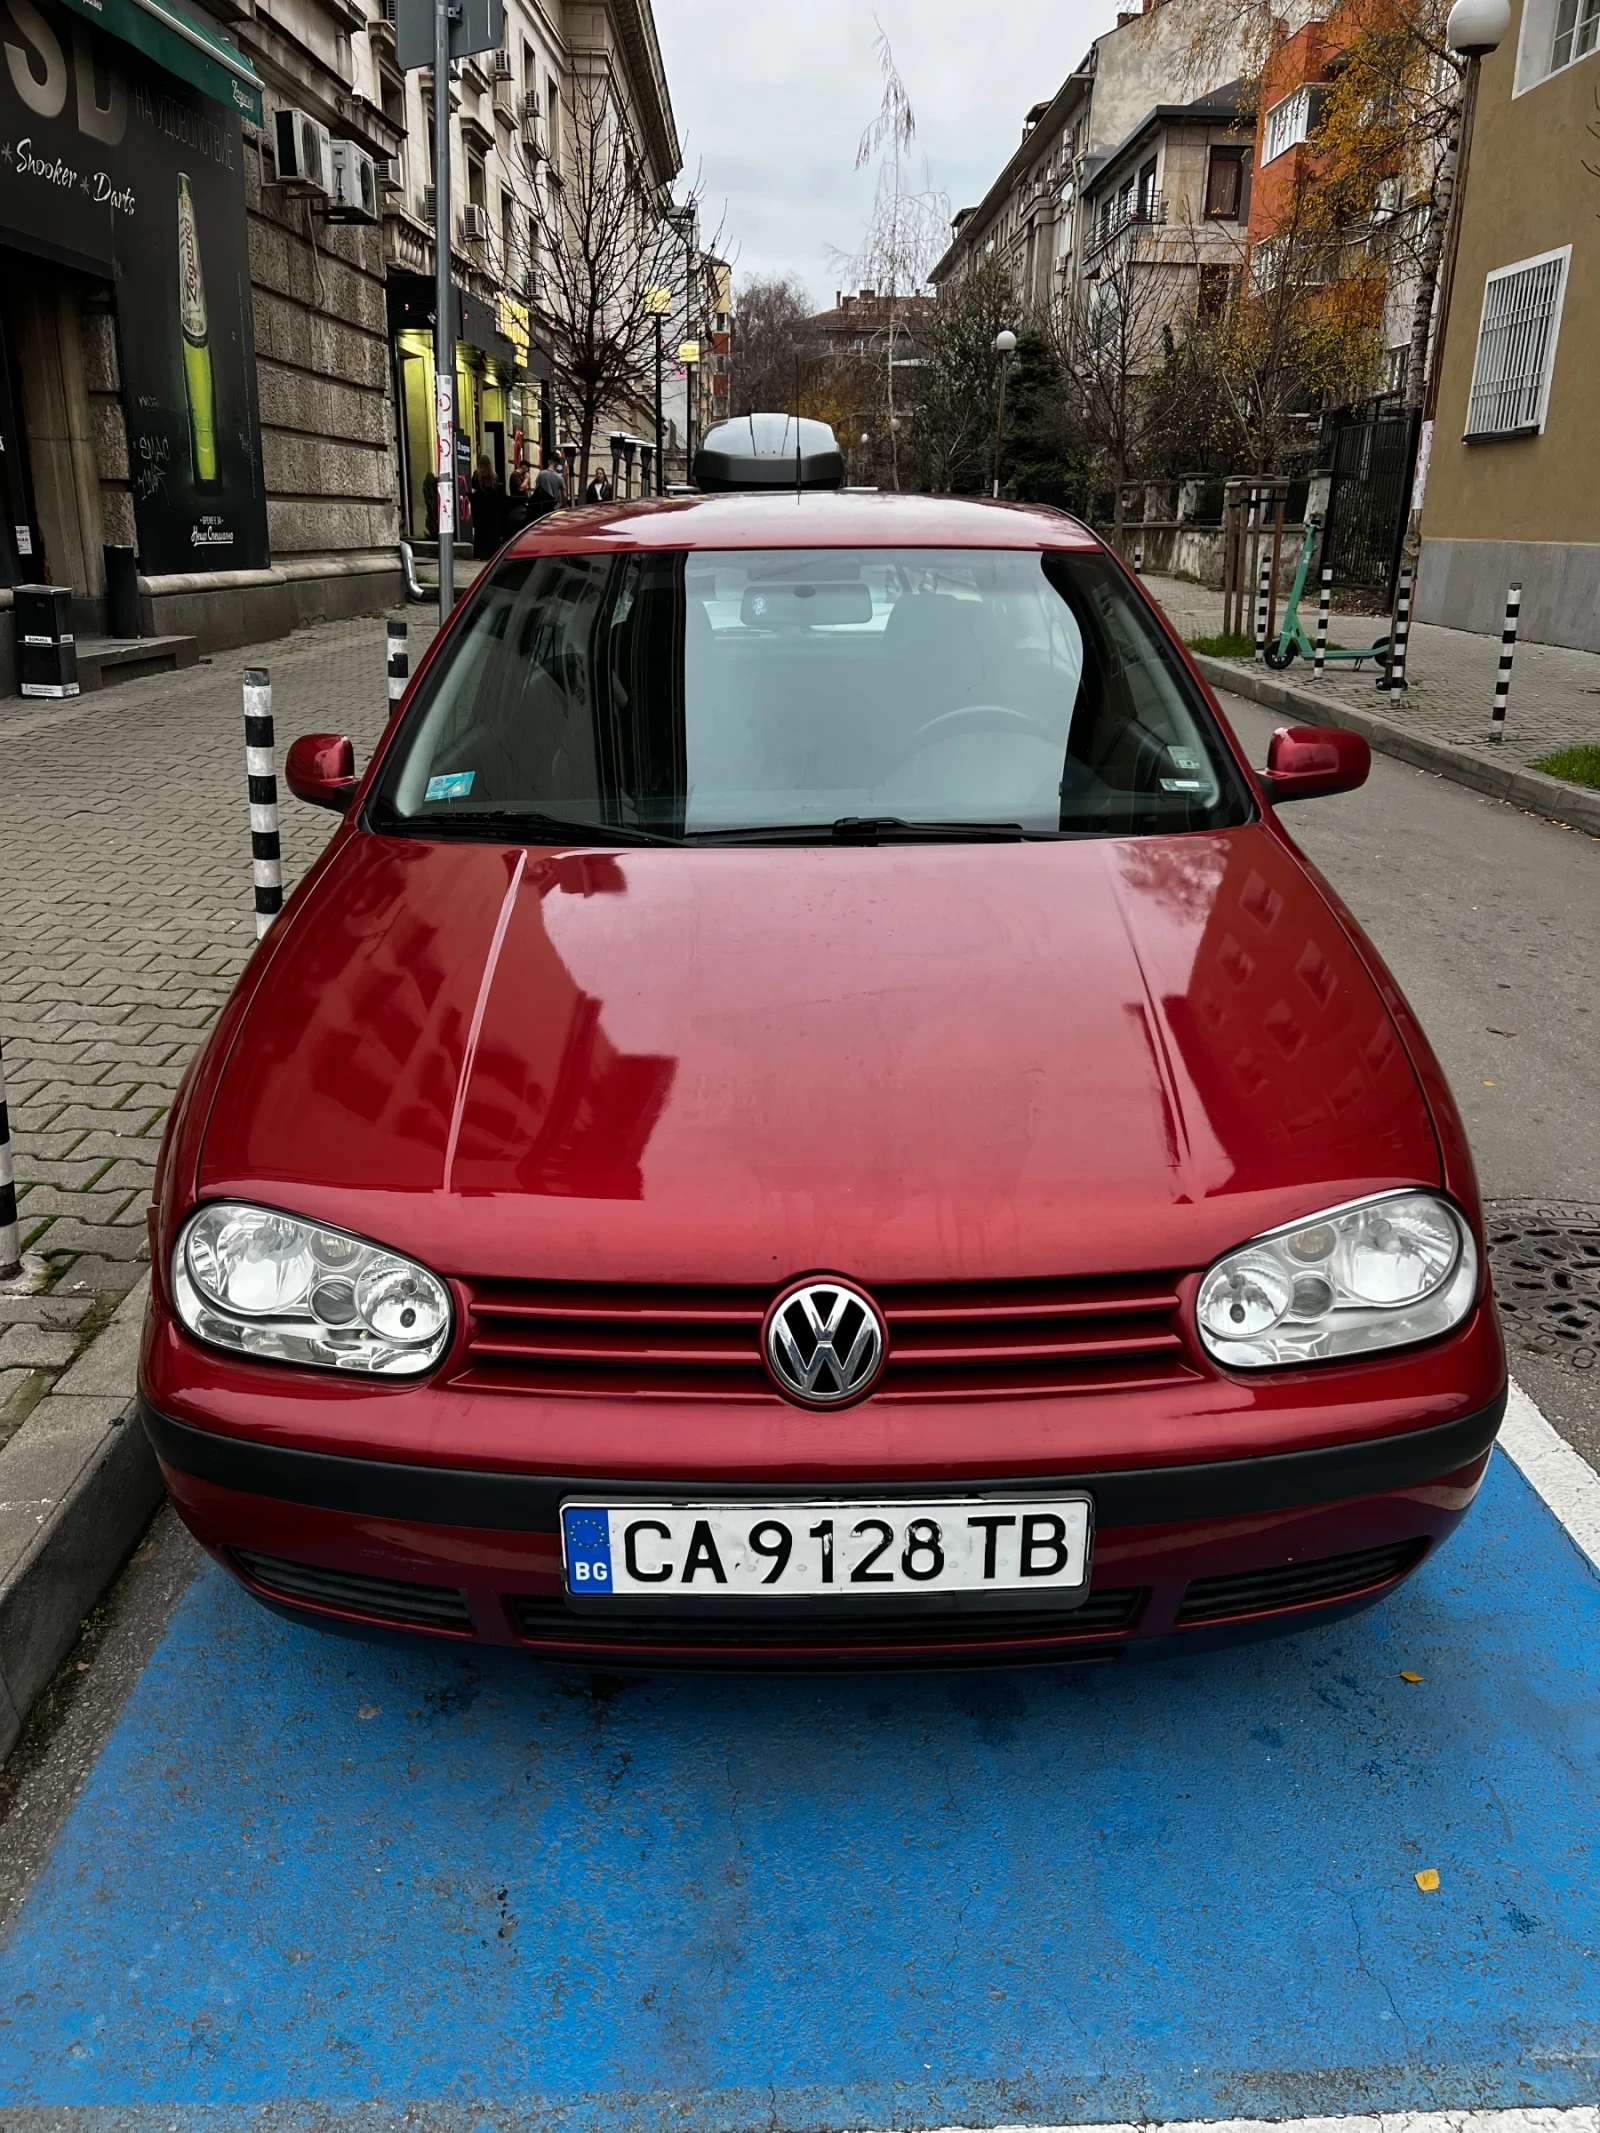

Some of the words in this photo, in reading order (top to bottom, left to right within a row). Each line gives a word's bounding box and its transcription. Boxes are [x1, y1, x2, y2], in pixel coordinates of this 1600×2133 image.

[16, 138, 77, 188] Snooker
[93, 172, 135, 216] Darts
[184, 217, 197, 304] Zagorka
[575, 1561, 608, 1581] BG
[624, 1519, 728, 1584] CA
[748, 1518, 945, 1584] 9128
[967, 1512, 1069, 1579] TB
